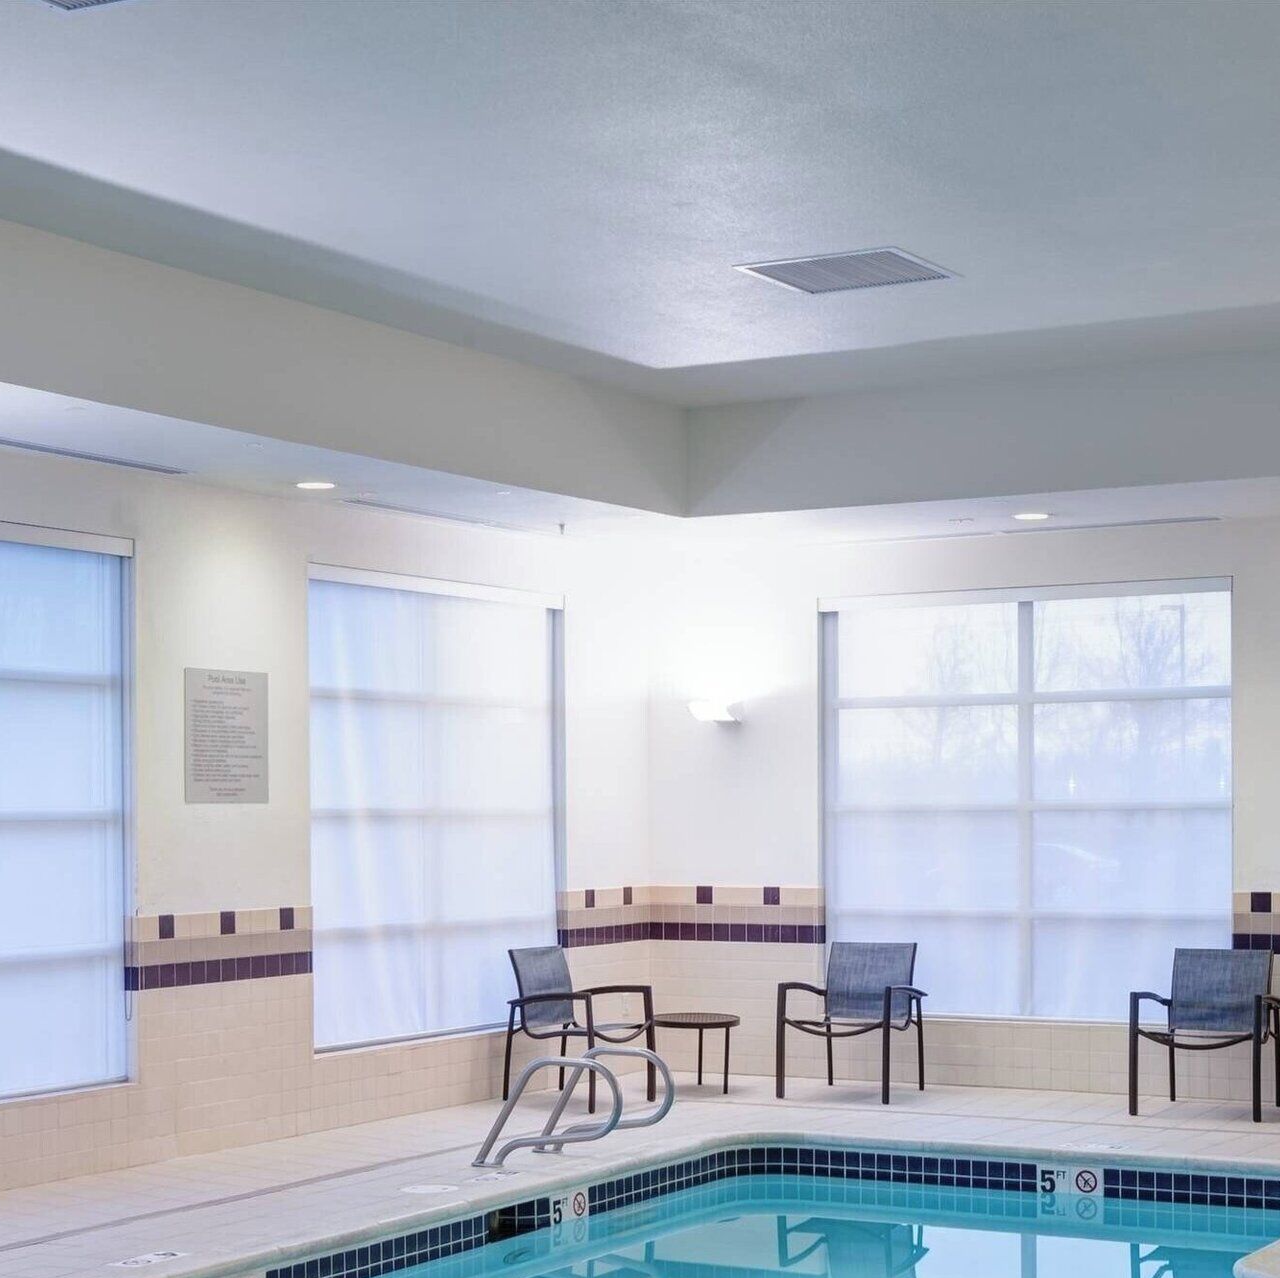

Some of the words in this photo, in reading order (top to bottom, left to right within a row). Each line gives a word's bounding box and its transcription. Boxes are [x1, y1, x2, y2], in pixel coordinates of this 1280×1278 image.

[1041, 1170, 1056, 1193] 5
[1056, 1171, 1067, 1180] FT
[553, 1199, 562, 1224] 5
